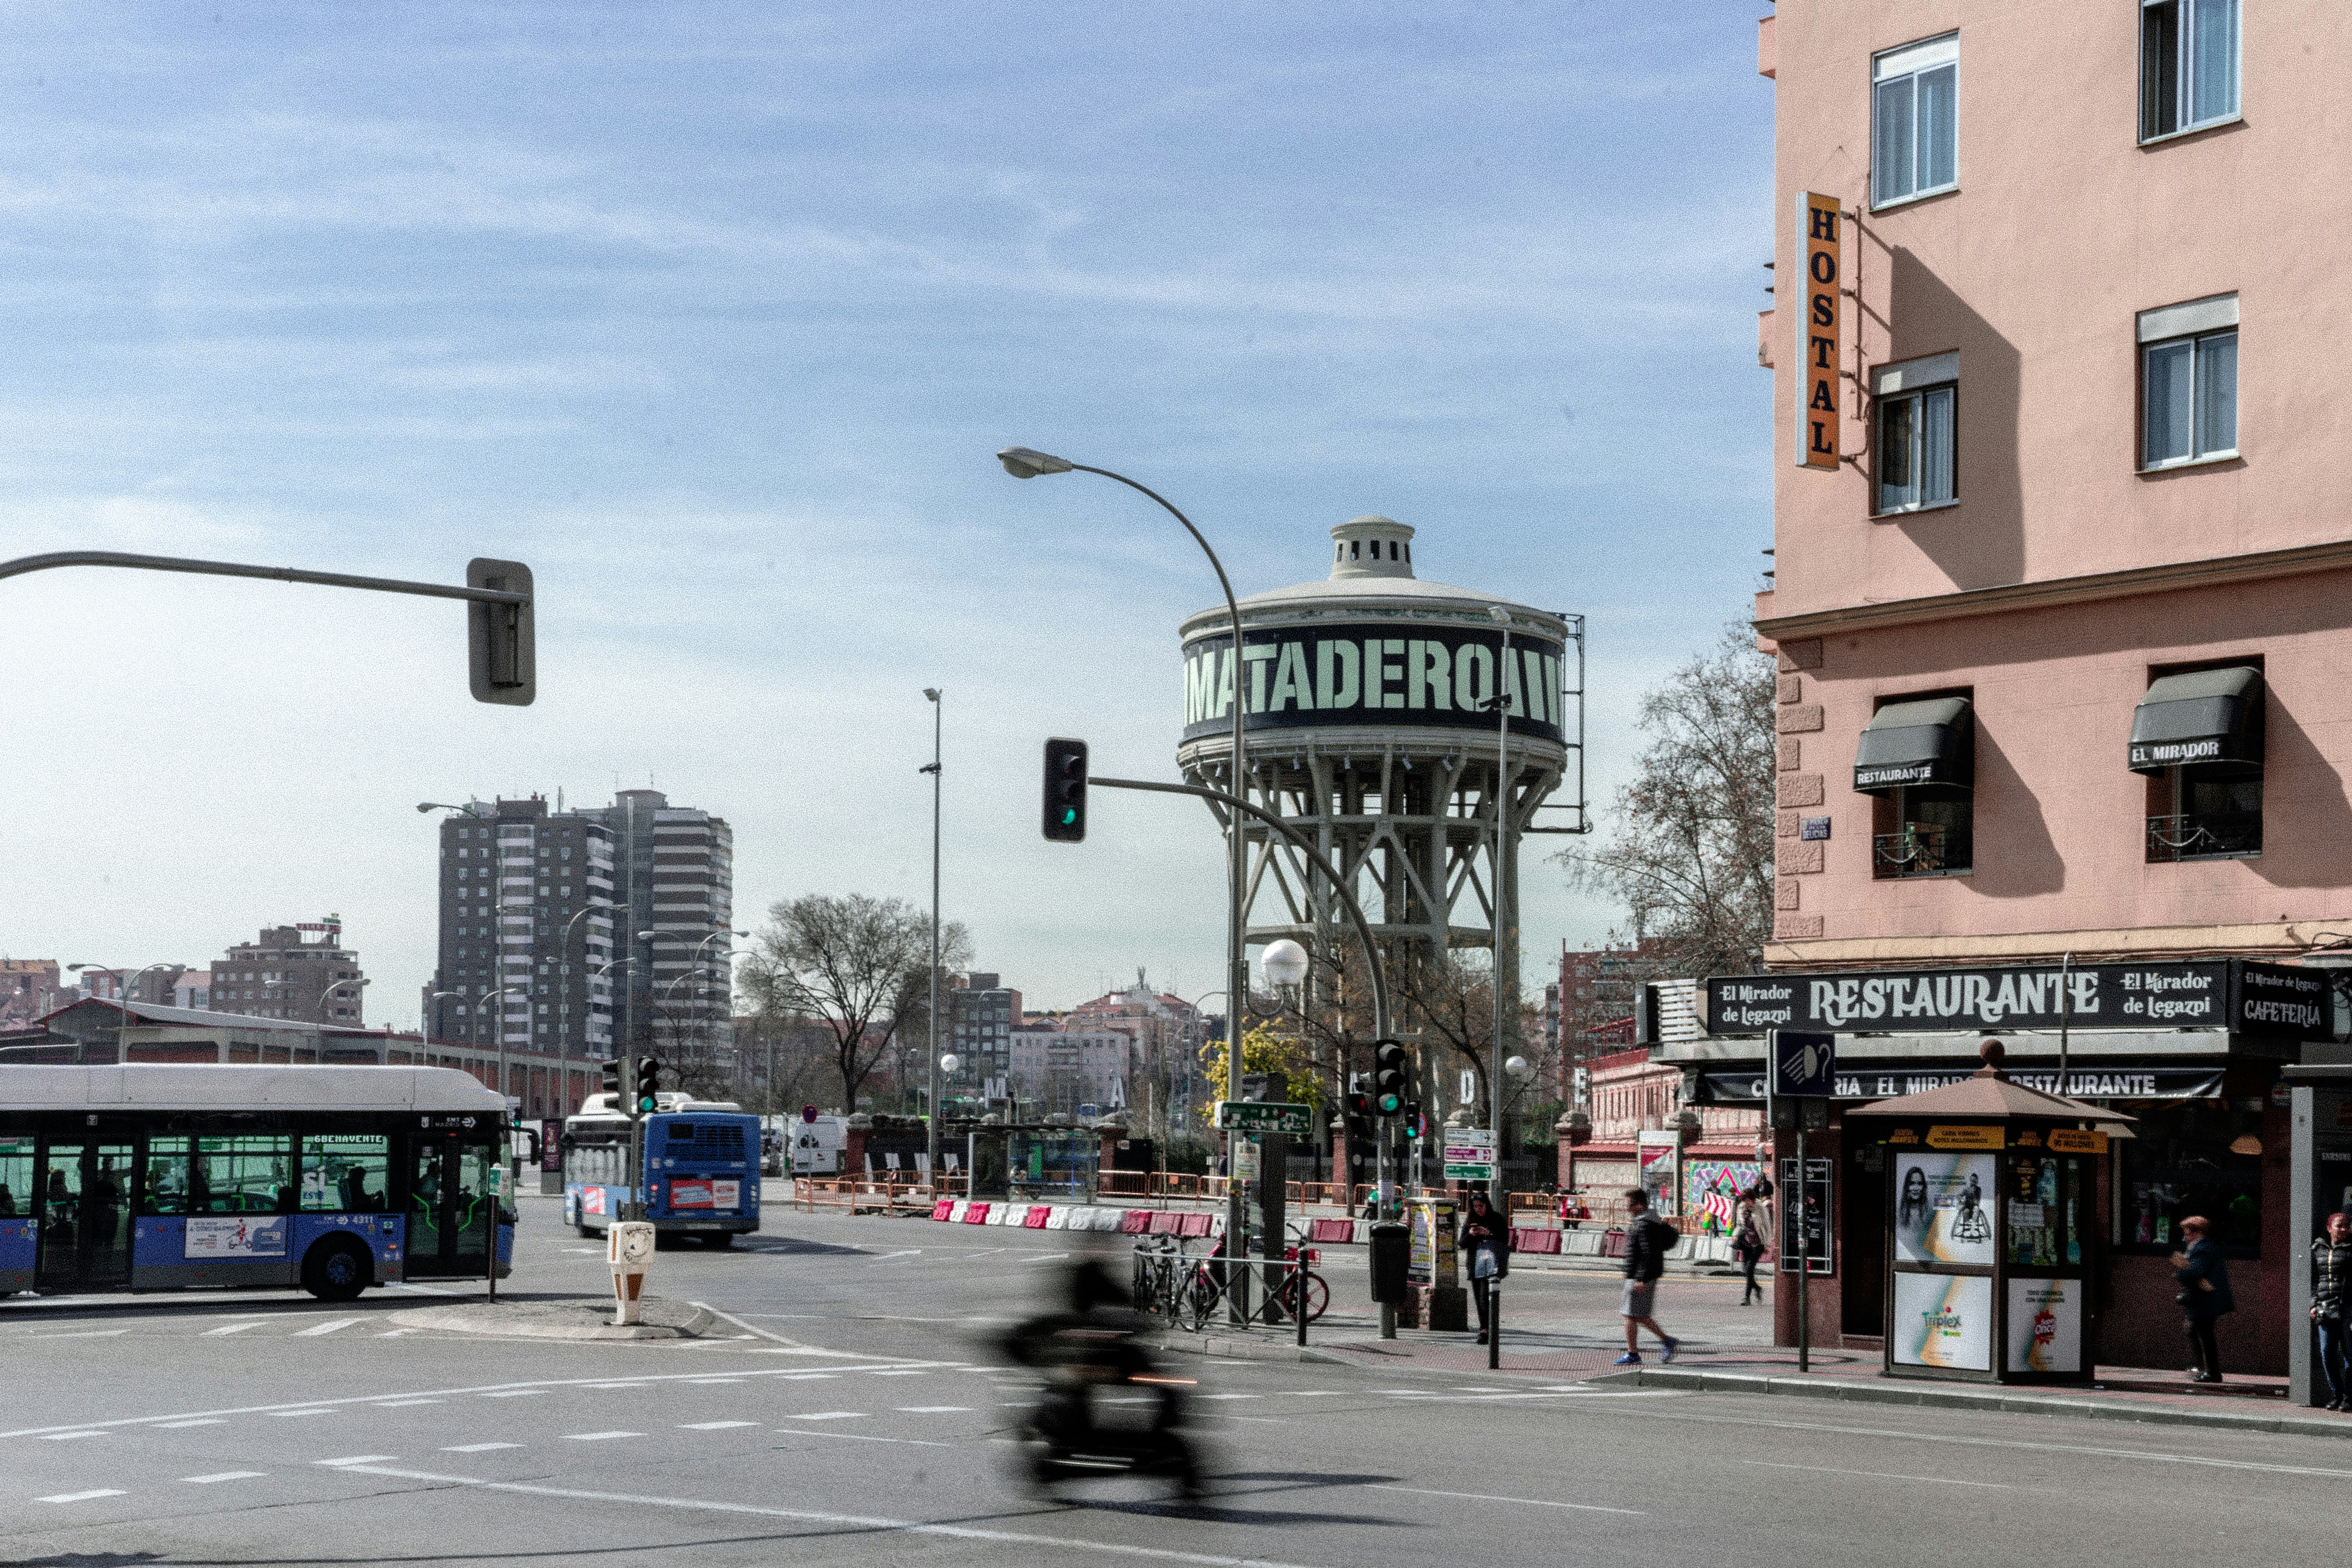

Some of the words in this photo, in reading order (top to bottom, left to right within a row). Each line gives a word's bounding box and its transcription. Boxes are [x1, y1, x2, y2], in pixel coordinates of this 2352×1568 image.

[1810, 207, 1836, 455] HOSTAL
[2132, 748, 2149, 762] EL
[2153, 742, 2219, 760] MIRADOR
[1857, 766, 1931, 784] RESTAURANTE
[2120, 972, 2141, 990] El
[2145, 971, 2212, 993] Mirador
[2244, 971, 2254, 984] El
[2255, 973, 2284, 987] Mirador
[2285, 976, 2294, 987] de
[1719, 985, 1736, 1001] El
[1739, 984, 1792, 1004] Mirador
[1809, 972, 2100, 1026] RESTAURANTE
[1722, 1006, 1739, 1022] de
[1741, 1006, 1791, 1025] Legazpi
[2123, 996, 2144, 1013] de
[2148, 996, 2210, 1018] Legazpi
[2244, 999, 2321, 1028] CAFETERÍA
[1877, 1077, 1898, 1095] EL
[352, 1216, 373, 1224] 4311
[1921, 1311, 1962, 1328] Triplex
